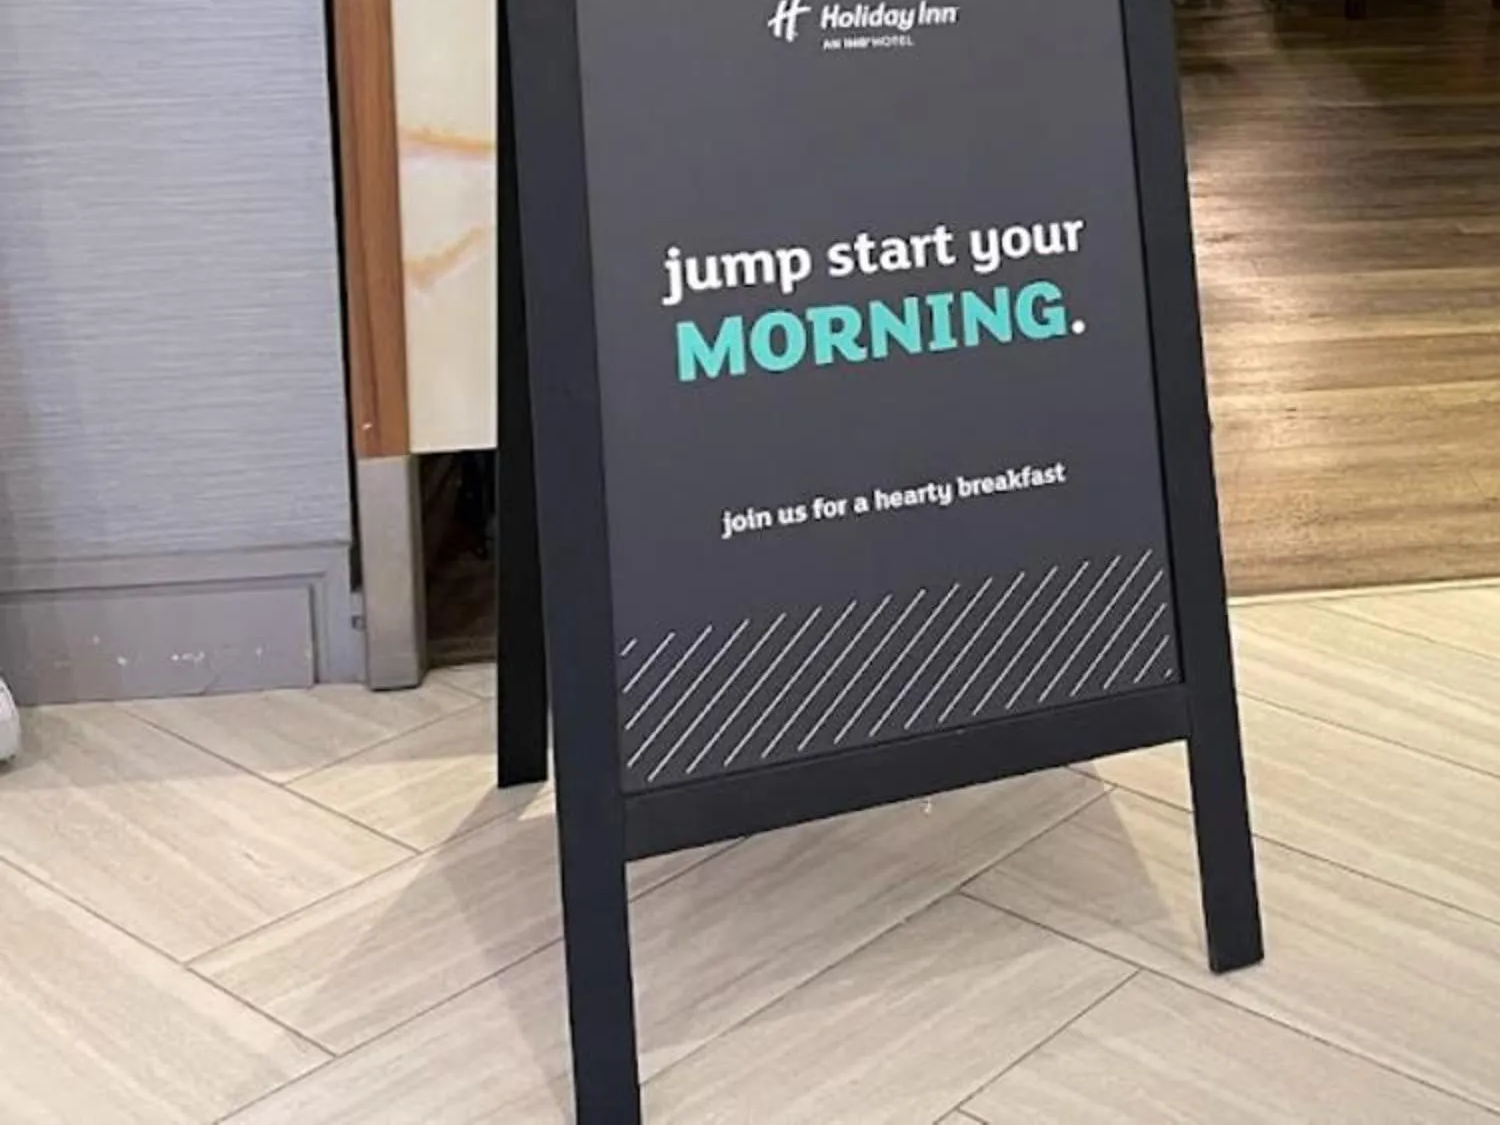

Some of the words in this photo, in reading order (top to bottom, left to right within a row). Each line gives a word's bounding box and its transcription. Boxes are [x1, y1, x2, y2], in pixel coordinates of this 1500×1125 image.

[820, 1, 915, 31] Holiday
[917, 0, 959, 25] Inn
[662, 245, 812, 305] jump
[827, 225, 956, 276] start
[969, 219, 1084, 274] your
[675, 280, 1086, 382] MORNING.
[721, 506, 772, 538] join
[778, 505, 808, 525] us
[813, 495, 847, 520] for
[854, 495, 870, 515] a
[875, 481, 952, 512] hearty
[957, 461, 1067, 498] breakfast
